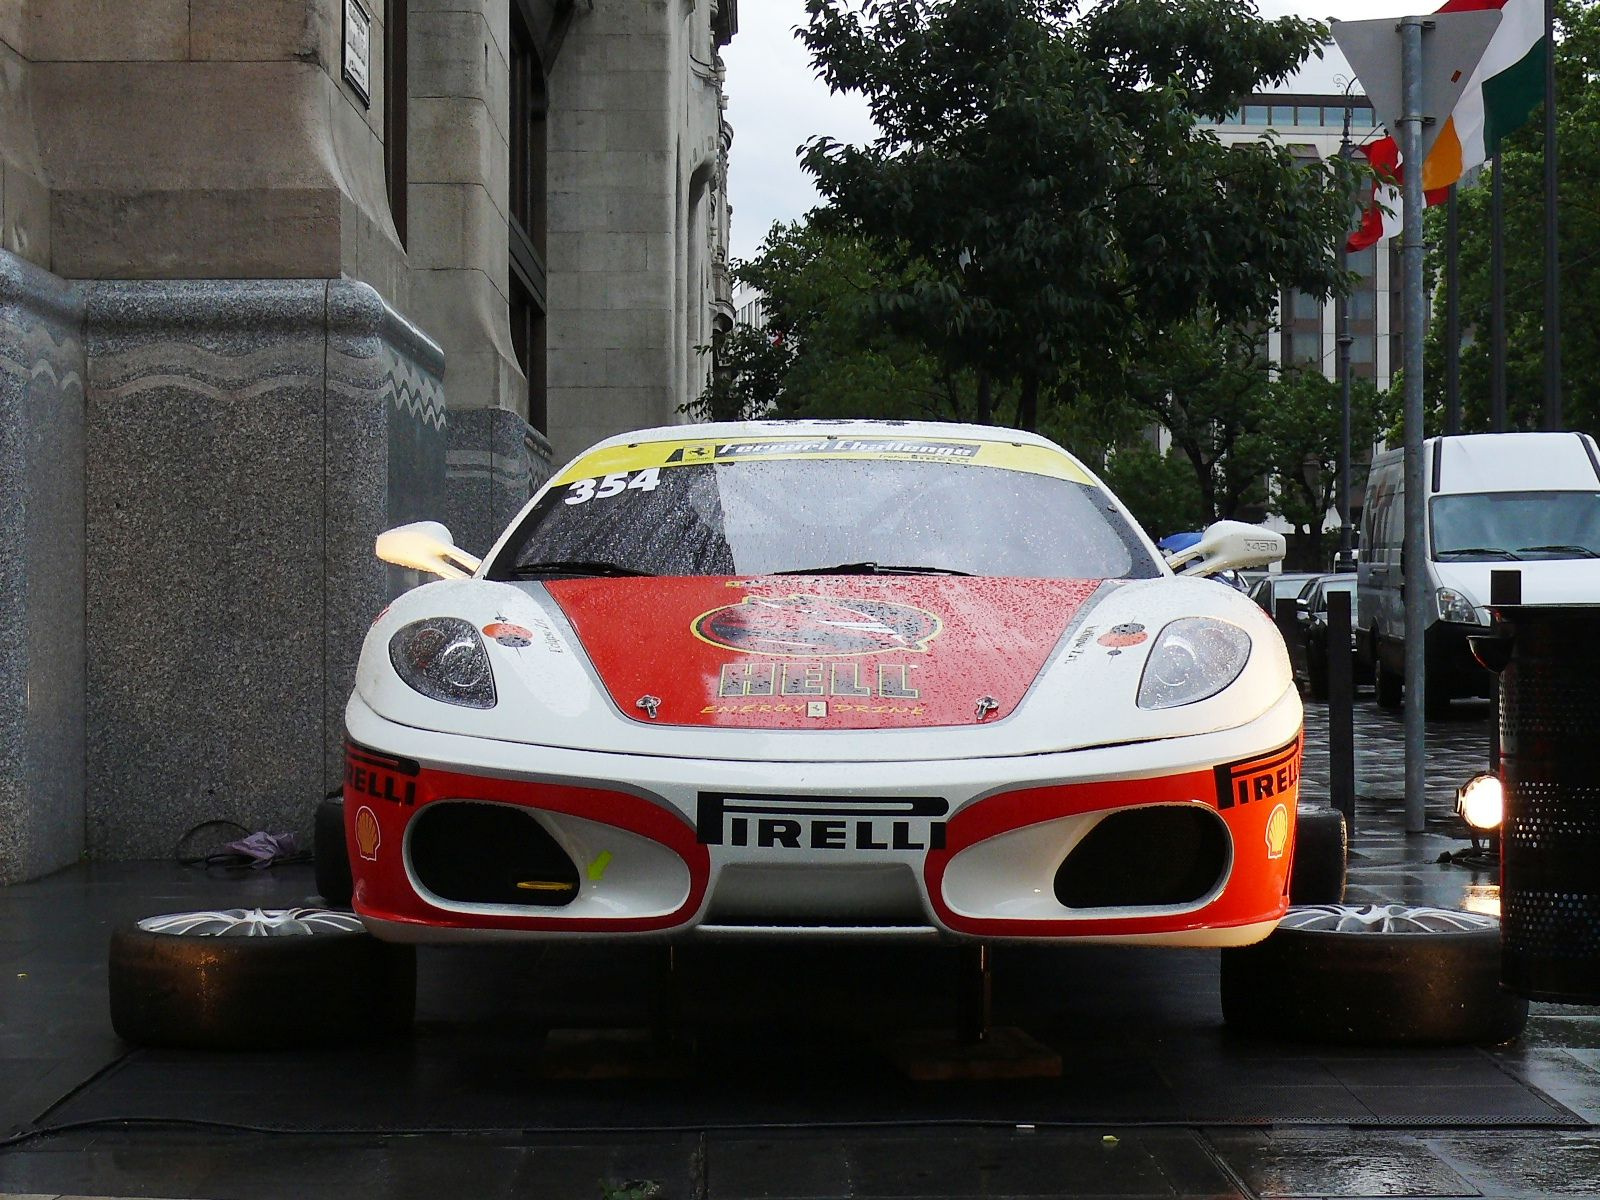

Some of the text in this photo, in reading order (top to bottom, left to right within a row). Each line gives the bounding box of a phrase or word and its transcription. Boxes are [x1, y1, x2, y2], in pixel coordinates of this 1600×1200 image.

[564, 467, 661, 505] 354
[717, 662, 920, 699] HELL
[700, 703, 925, 716] ENERGY DRINK
[345, 742, 420, 807] RELLI
[697, 791, 949, 850] PIRELLI
